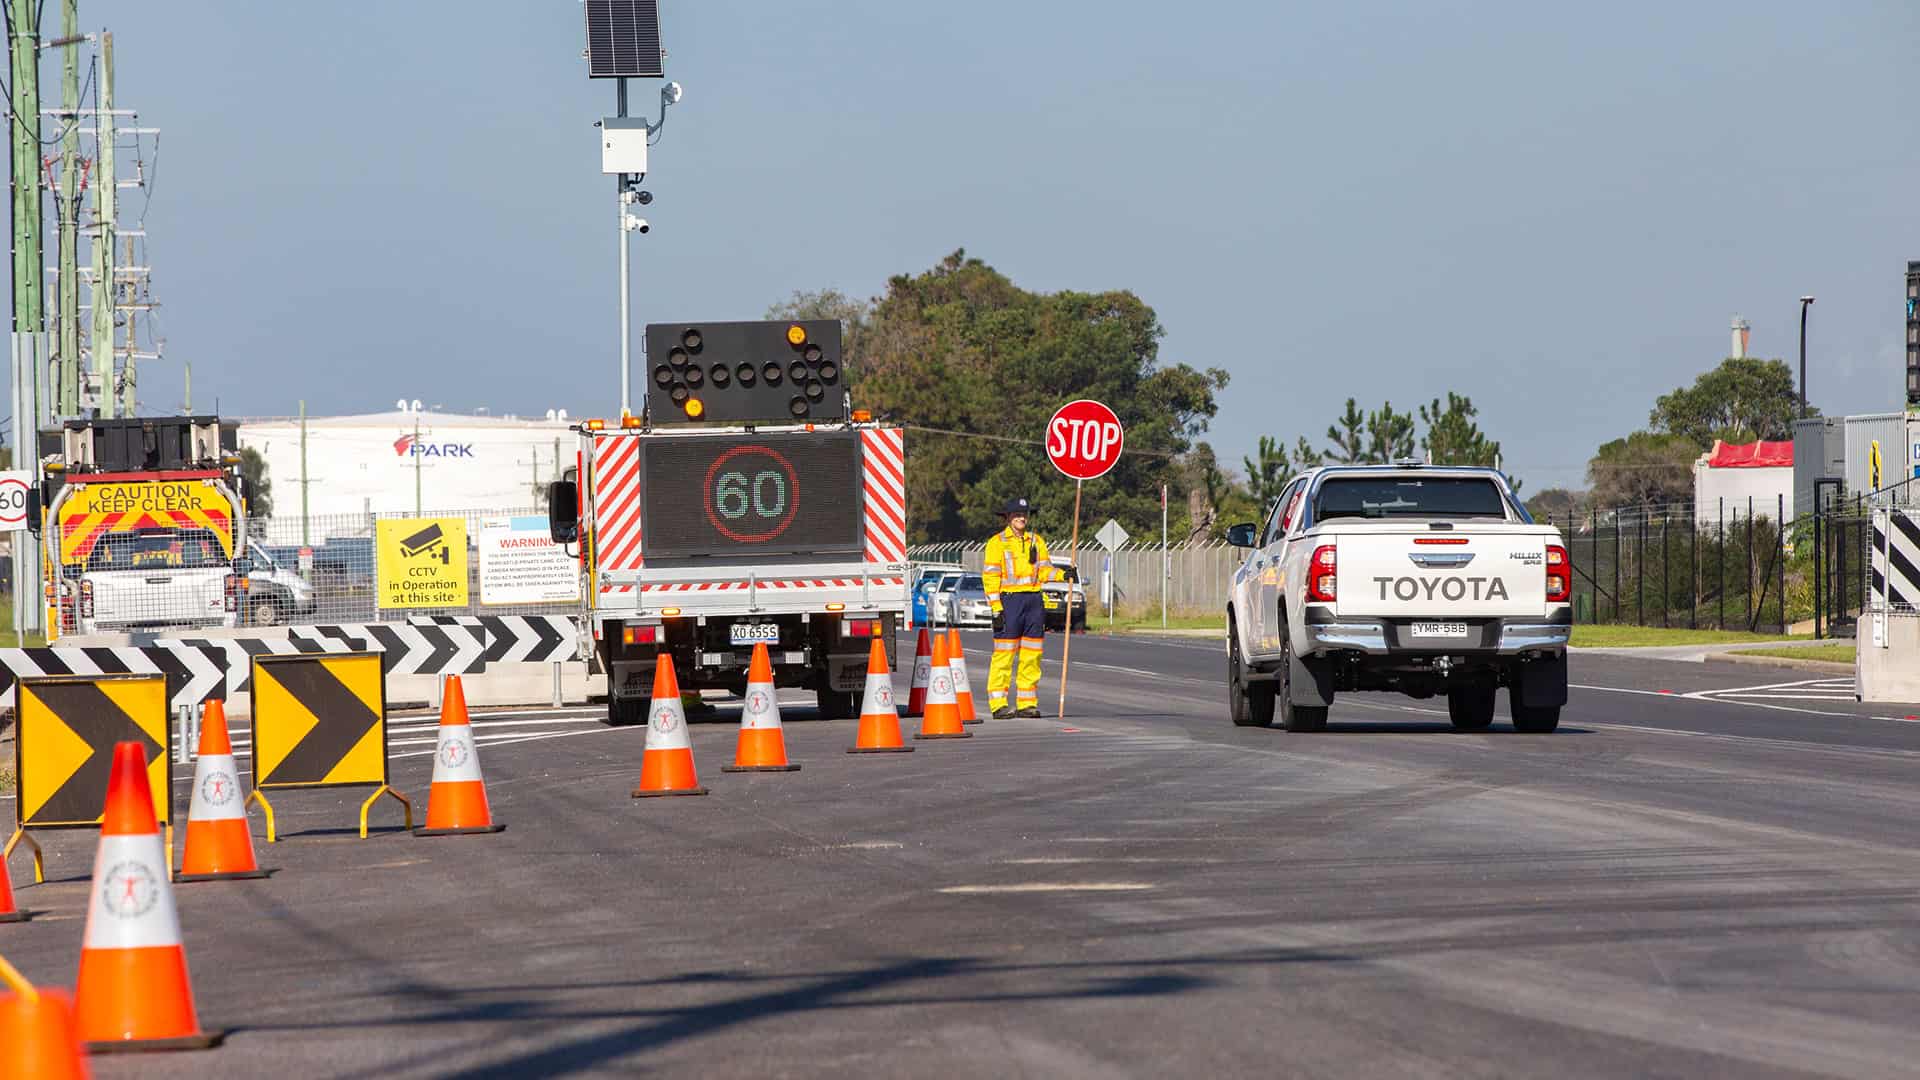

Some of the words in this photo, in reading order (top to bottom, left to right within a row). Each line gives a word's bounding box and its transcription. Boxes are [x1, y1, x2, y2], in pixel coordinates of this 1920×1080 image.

[1049, 417, 1120, 462] STOP
[410, 443, 473, 457] PARK
[0, 490, 25, 510] 60
[99, 484, 190, 500] CAUTION
[717, 471, 785, 519] 60
[88, 499, 136, 513] KEEP
[142, 497, 202, 512] CLEAR
[1509, 551, 1543, 560] HILUX
[408, 567, 438, 577] CCTV
[389, 580, 400, 591] in
[402, 580, 457, 592] Operation
[1373, 576, 1510, 602] TOYOTA
[392, 593, 405, 603] at
[408, 592, 430, 603] this
[433, 591, 455, 602] site
